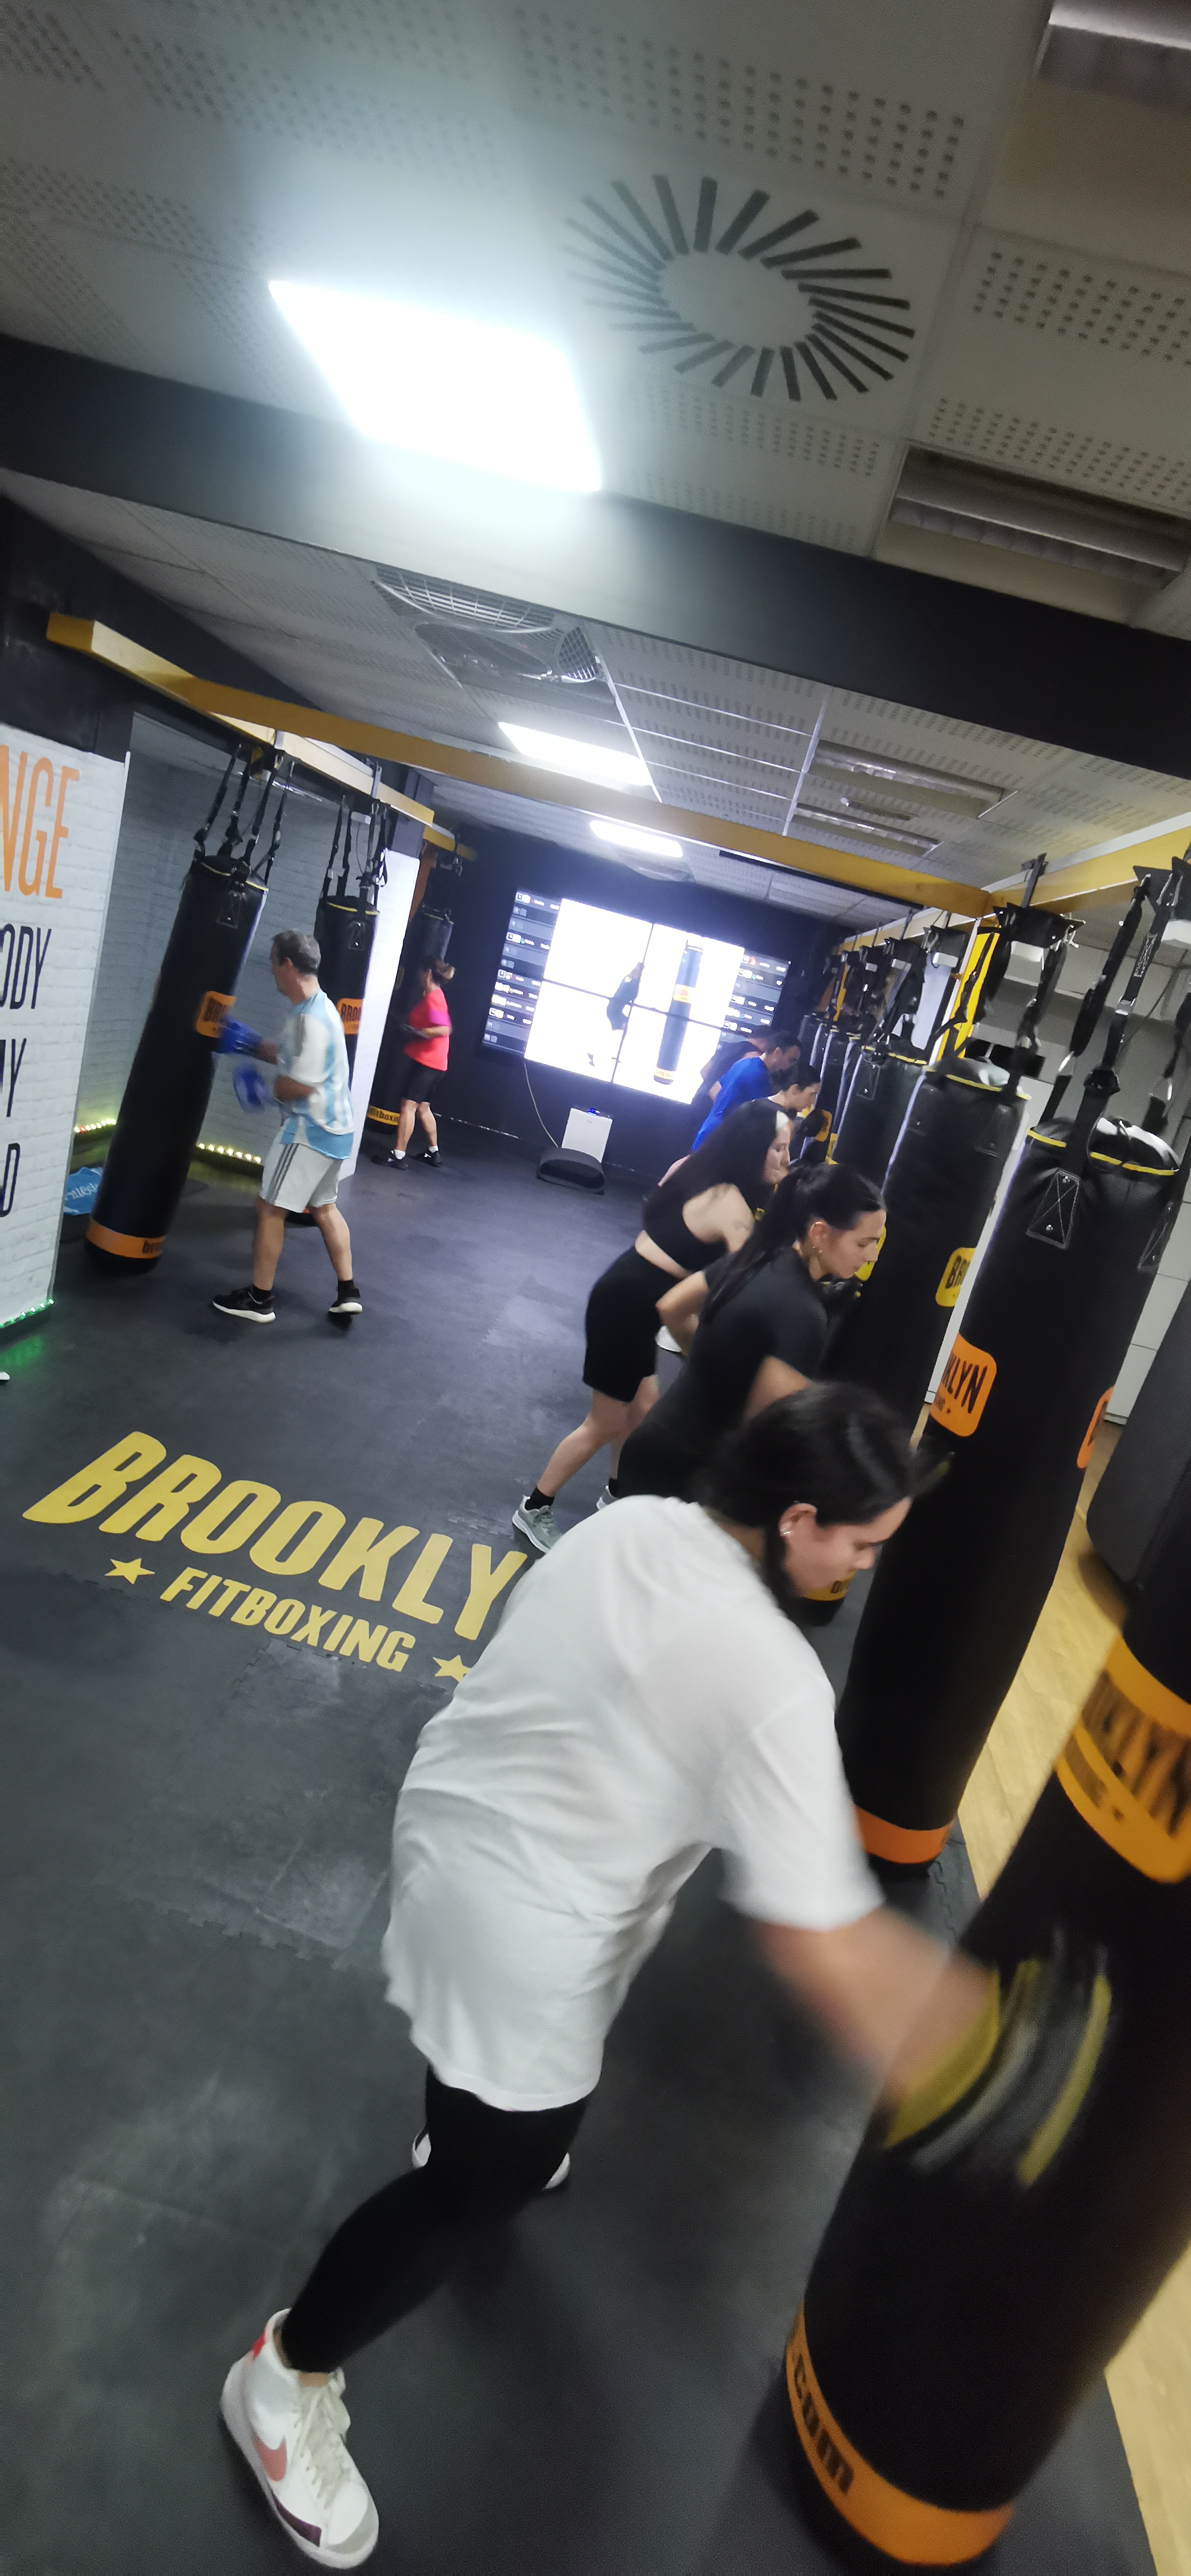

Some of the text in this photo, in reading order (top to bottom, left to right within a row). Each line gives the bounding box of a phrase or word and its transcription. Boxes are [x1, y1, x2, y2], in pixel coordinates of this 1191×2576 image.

[0, 745, 80, 899] NGE
[0, 1038, 27, 1117] Y
[944, 1352, 988, 1414] KLYN
[23, 1431, 528, 1640] BROOKLY
[160, 1567, 415, 1671] FITBOXING
